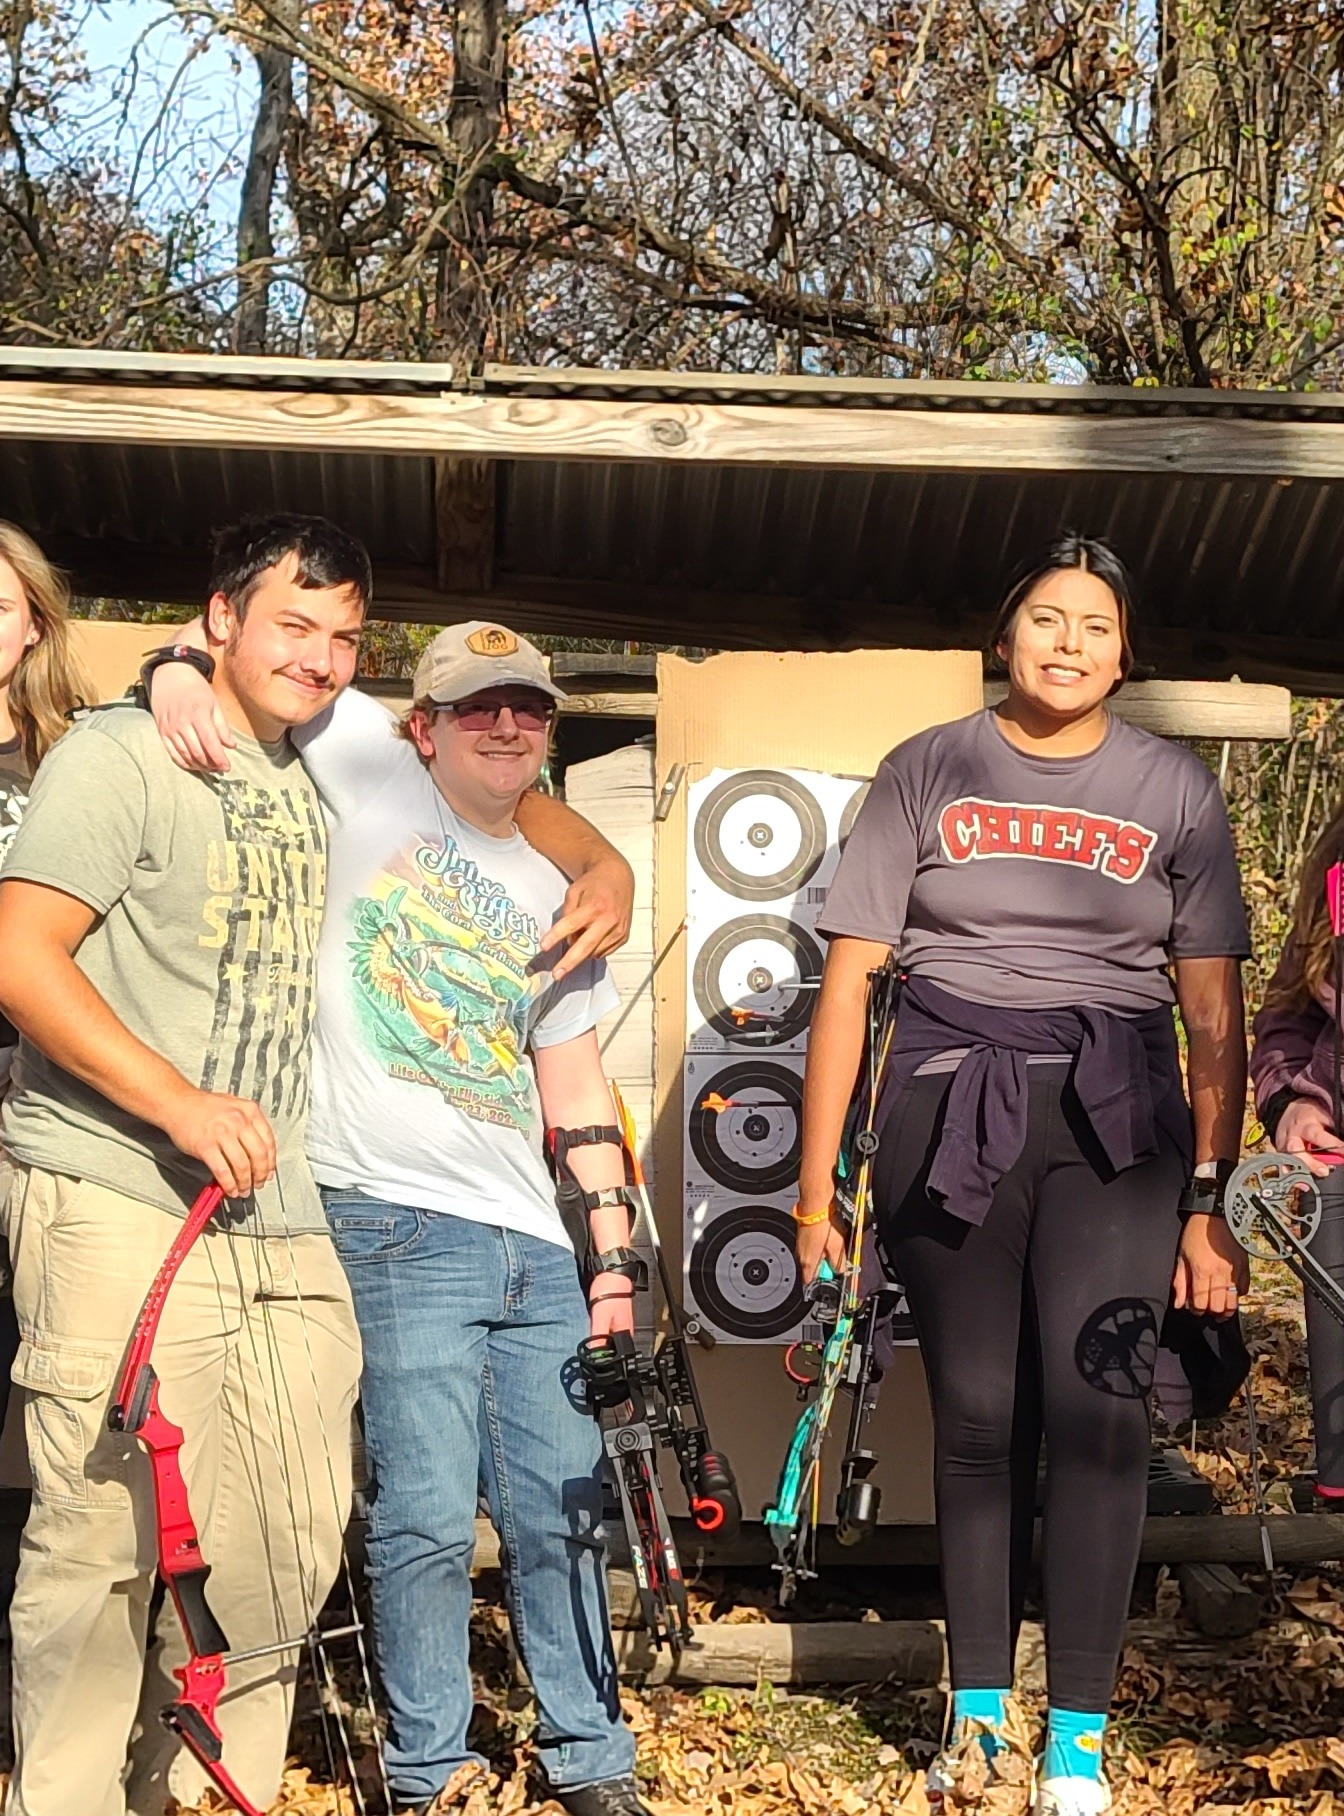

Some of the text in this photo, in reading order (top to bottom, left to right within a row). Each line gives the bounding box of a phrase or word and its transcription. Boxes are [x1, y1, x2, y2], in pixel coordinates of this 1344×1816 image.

[939, 798, 1156, 882] CHIEFS
[442, 906, 472, 931] Cora
[632, 1545, 648, 1589] FAZE
